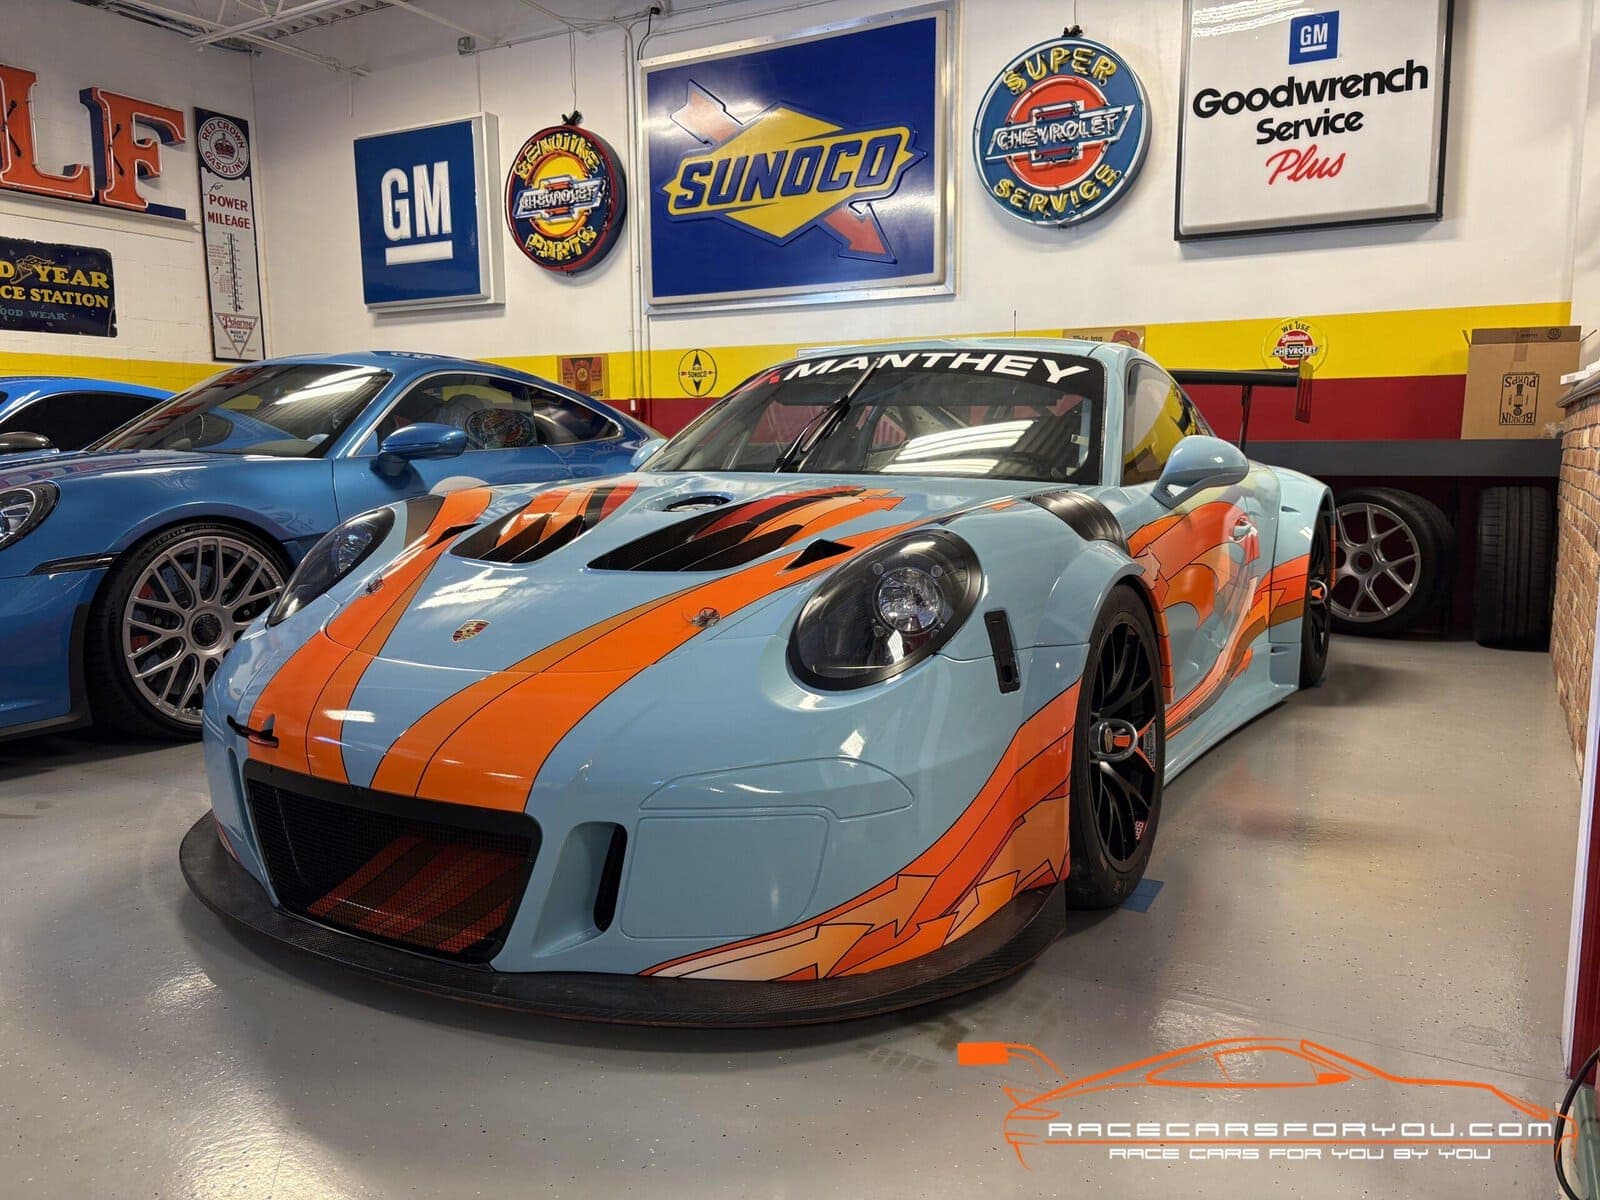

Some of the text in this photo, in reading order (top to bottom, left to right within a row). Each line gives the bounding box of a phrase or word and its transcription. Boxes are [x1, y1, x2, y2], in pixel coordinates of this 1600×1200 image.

[1300, 22, 1328, 46] GM
[1003, 47, 1117, 93] SUPER
[1192, 59, 1429, 119] Goodwrench
[202, 121, 245, 149] RED CROWN
[997, 114, 1119, 149] CHEVROLET
[1256, 108, 1364, 145] Service
[204, 150, 246, 174] GASOLINE
[514, 133, 600, 180] GENUINE
[1265, 144, 1347, 186] Plus
[673, 134, 903, 209] SUNOCO
[208, 193, 249, 212] POWER
[381, 160, 453, 242] GM
[520, 185, 594, 209] CHEVROLET
[994, 164, 1120, 213] SERVICE
[207, 211, 251, 230] MILEAGE
[527, 226, 597, 260] PARTS
[33, 264, 110, 290] YEAR
[30, 288, 109, 308] STATION
[29, 310, 67, 321] WEAR
[1281, 320, 1311, 333] WE USE
[1274, 345, 1319, 355] CHEVROLET
[783, 352, 1090, 385] MANTHEY
[1504, 375, 1537, 388] PUMPS
